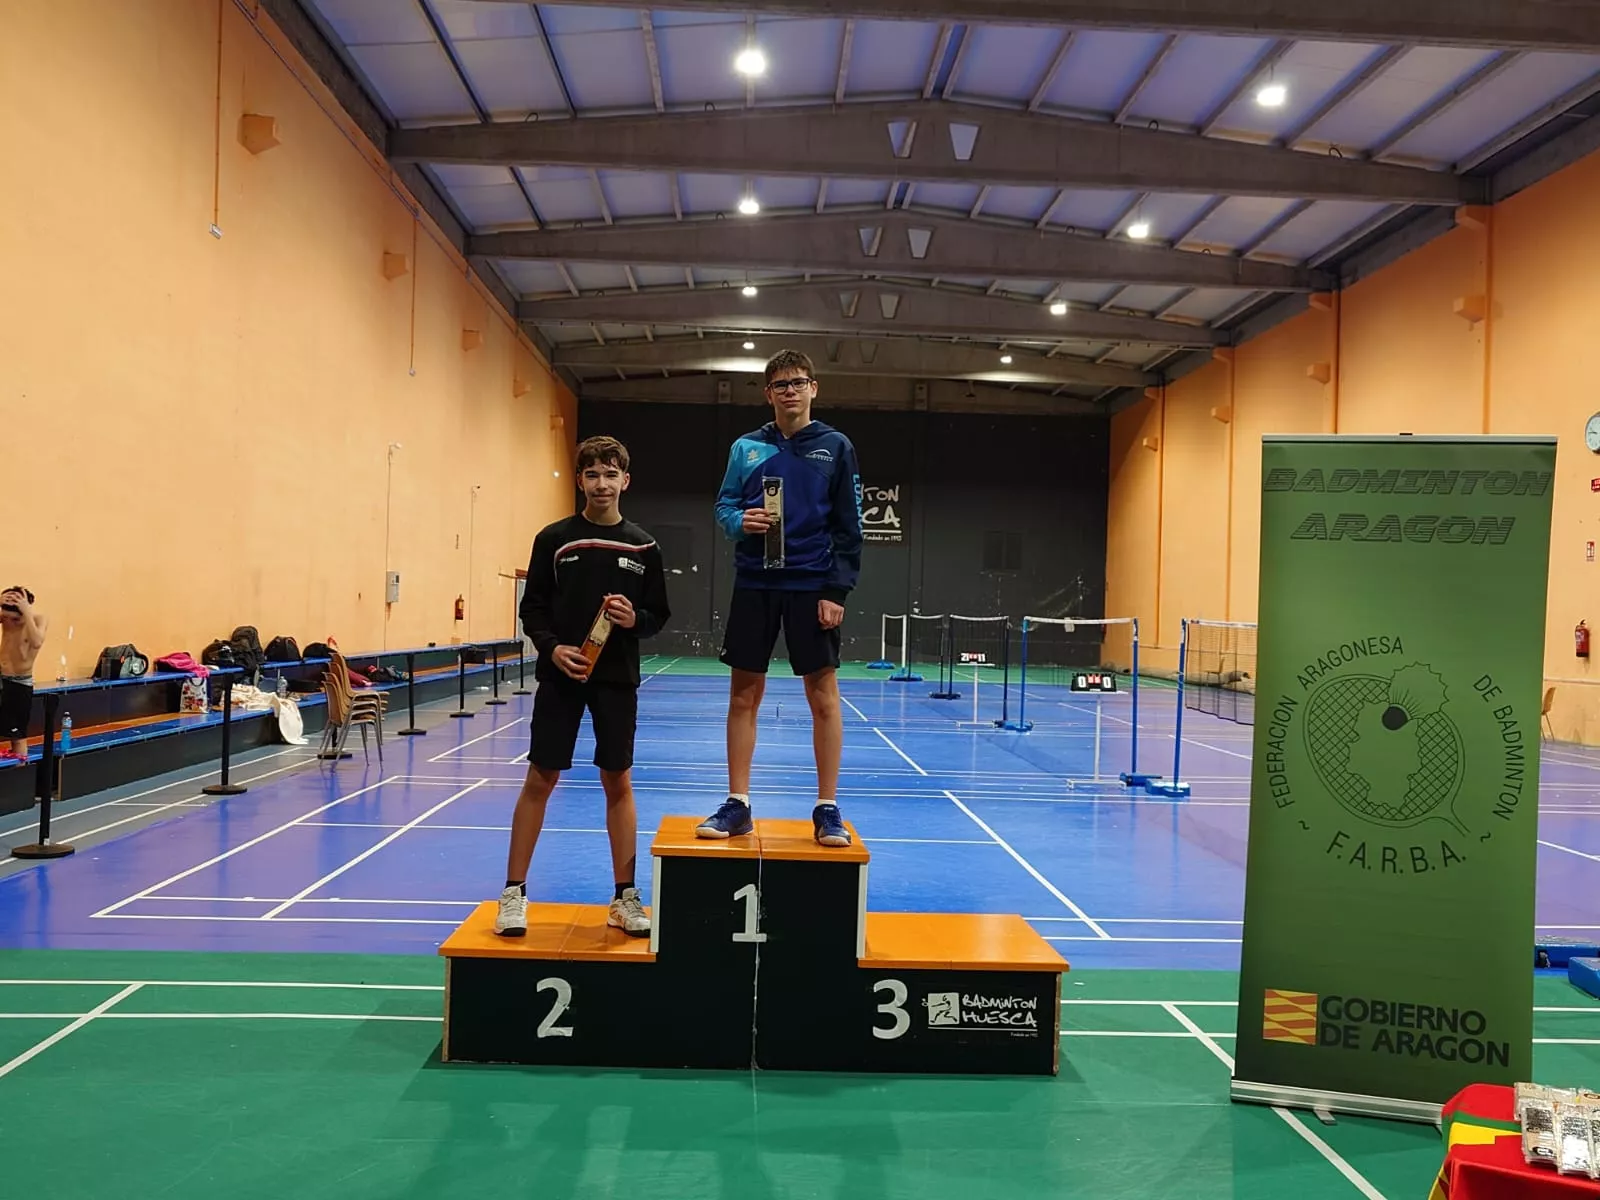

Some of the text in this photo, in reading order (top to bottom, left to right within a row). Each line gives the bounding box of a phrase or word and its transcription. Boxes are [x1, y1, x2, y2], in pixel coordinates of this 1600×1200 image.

[1263, 468, 1551, 496] BADMINTON
[1290, 512, 1516, 545] ARAGON
[1266, 636, 1525, 821] FEDERACION ARAGONESA DE BADMINTON
[732, 883, 767, 943] 1
[535, 976, 575, 1039] 2
[872, 978, 912, 1040] 3
[961, 1010, 1038, 1028] HUESCA
[1320, 994, 1487, 1036] GOBIERNO
[1319, 1021, 1510, 1068] DE ARAGON
